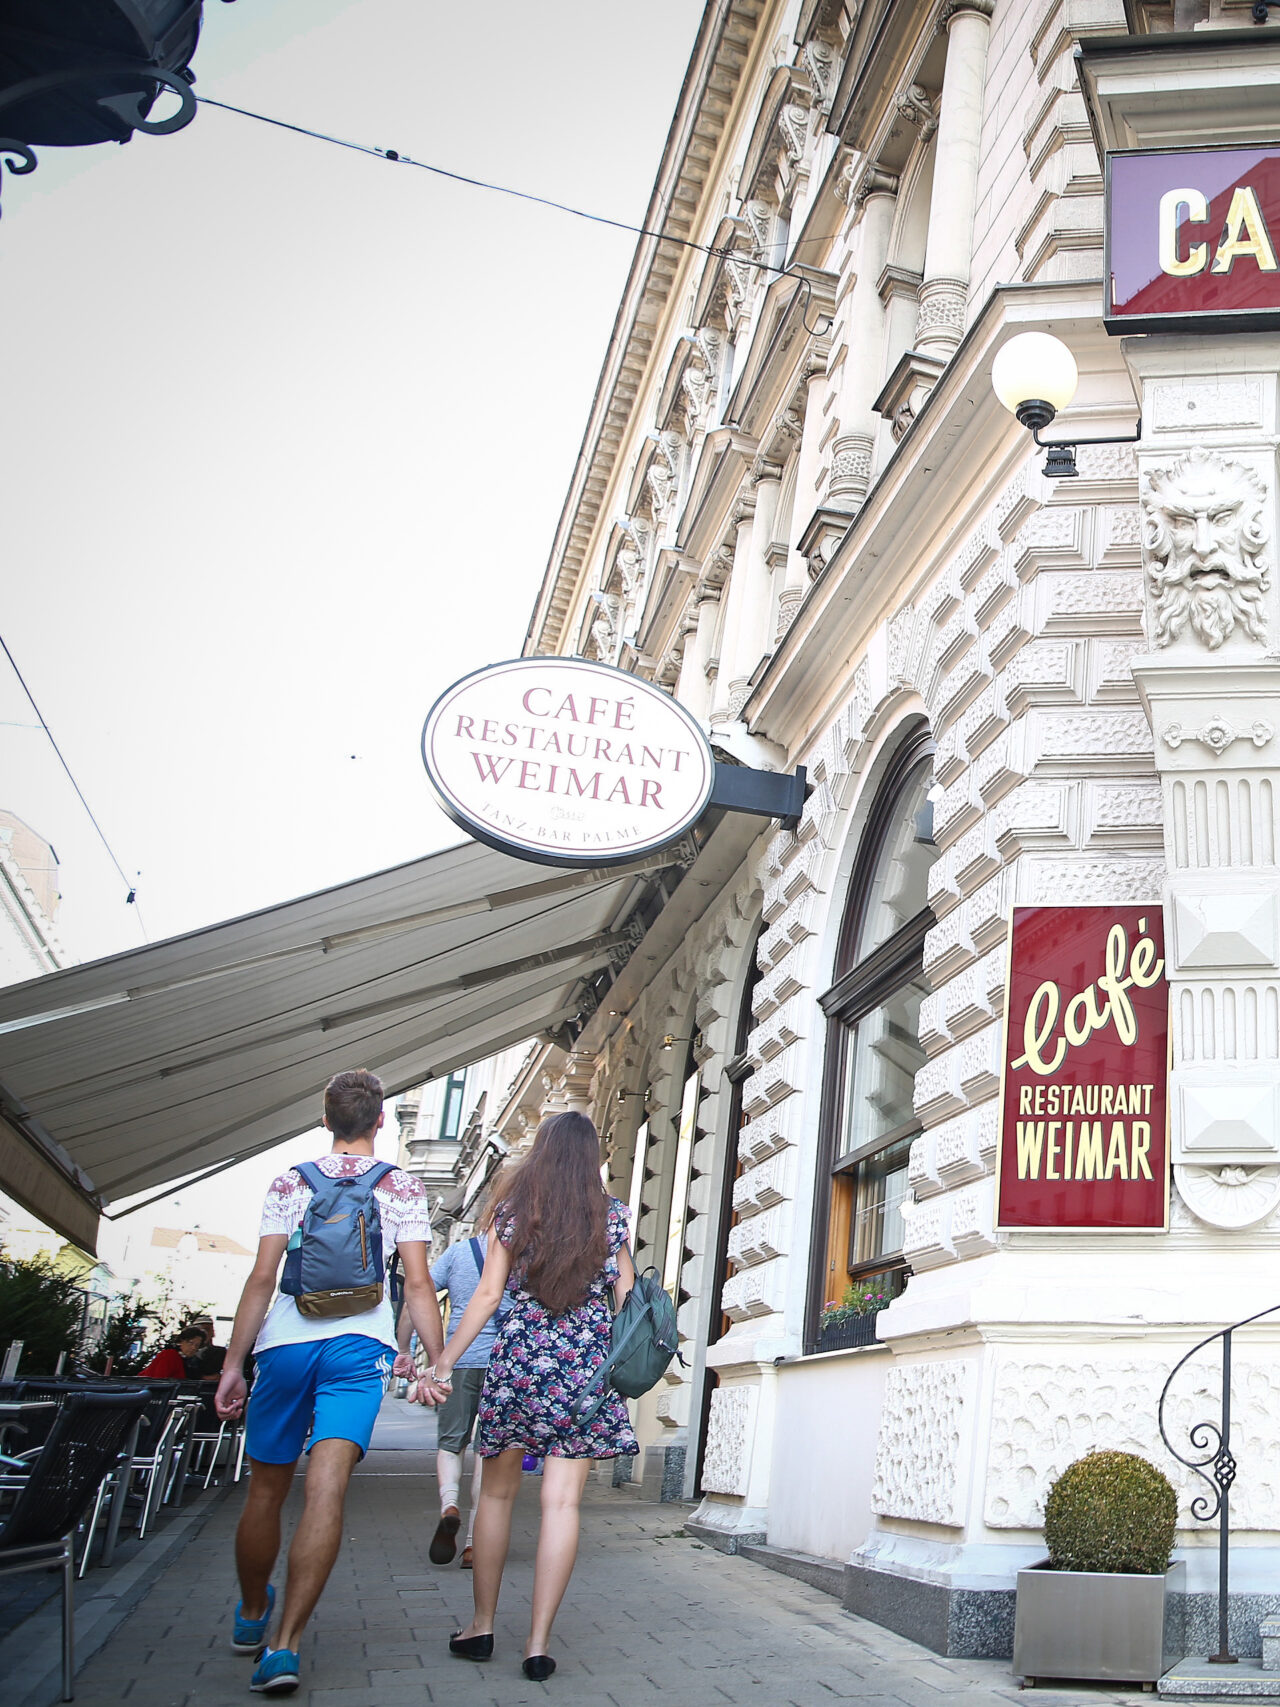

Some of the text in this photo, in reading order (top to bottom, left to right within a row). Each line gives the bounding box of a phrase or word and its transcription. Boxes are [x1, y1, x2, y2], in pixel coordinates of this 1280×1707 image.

[521, 687, 636, 732] CAFÉ
[453, 714, 691, 773] RESTAURANT
[469, 751, 665, 810] WEIMAR
[582, 824, 642, 843] PALME
[1019, 1084, 1155, 1116] RESTAURANT
[1016, 1120, 1155, 1182] WEIMAR
